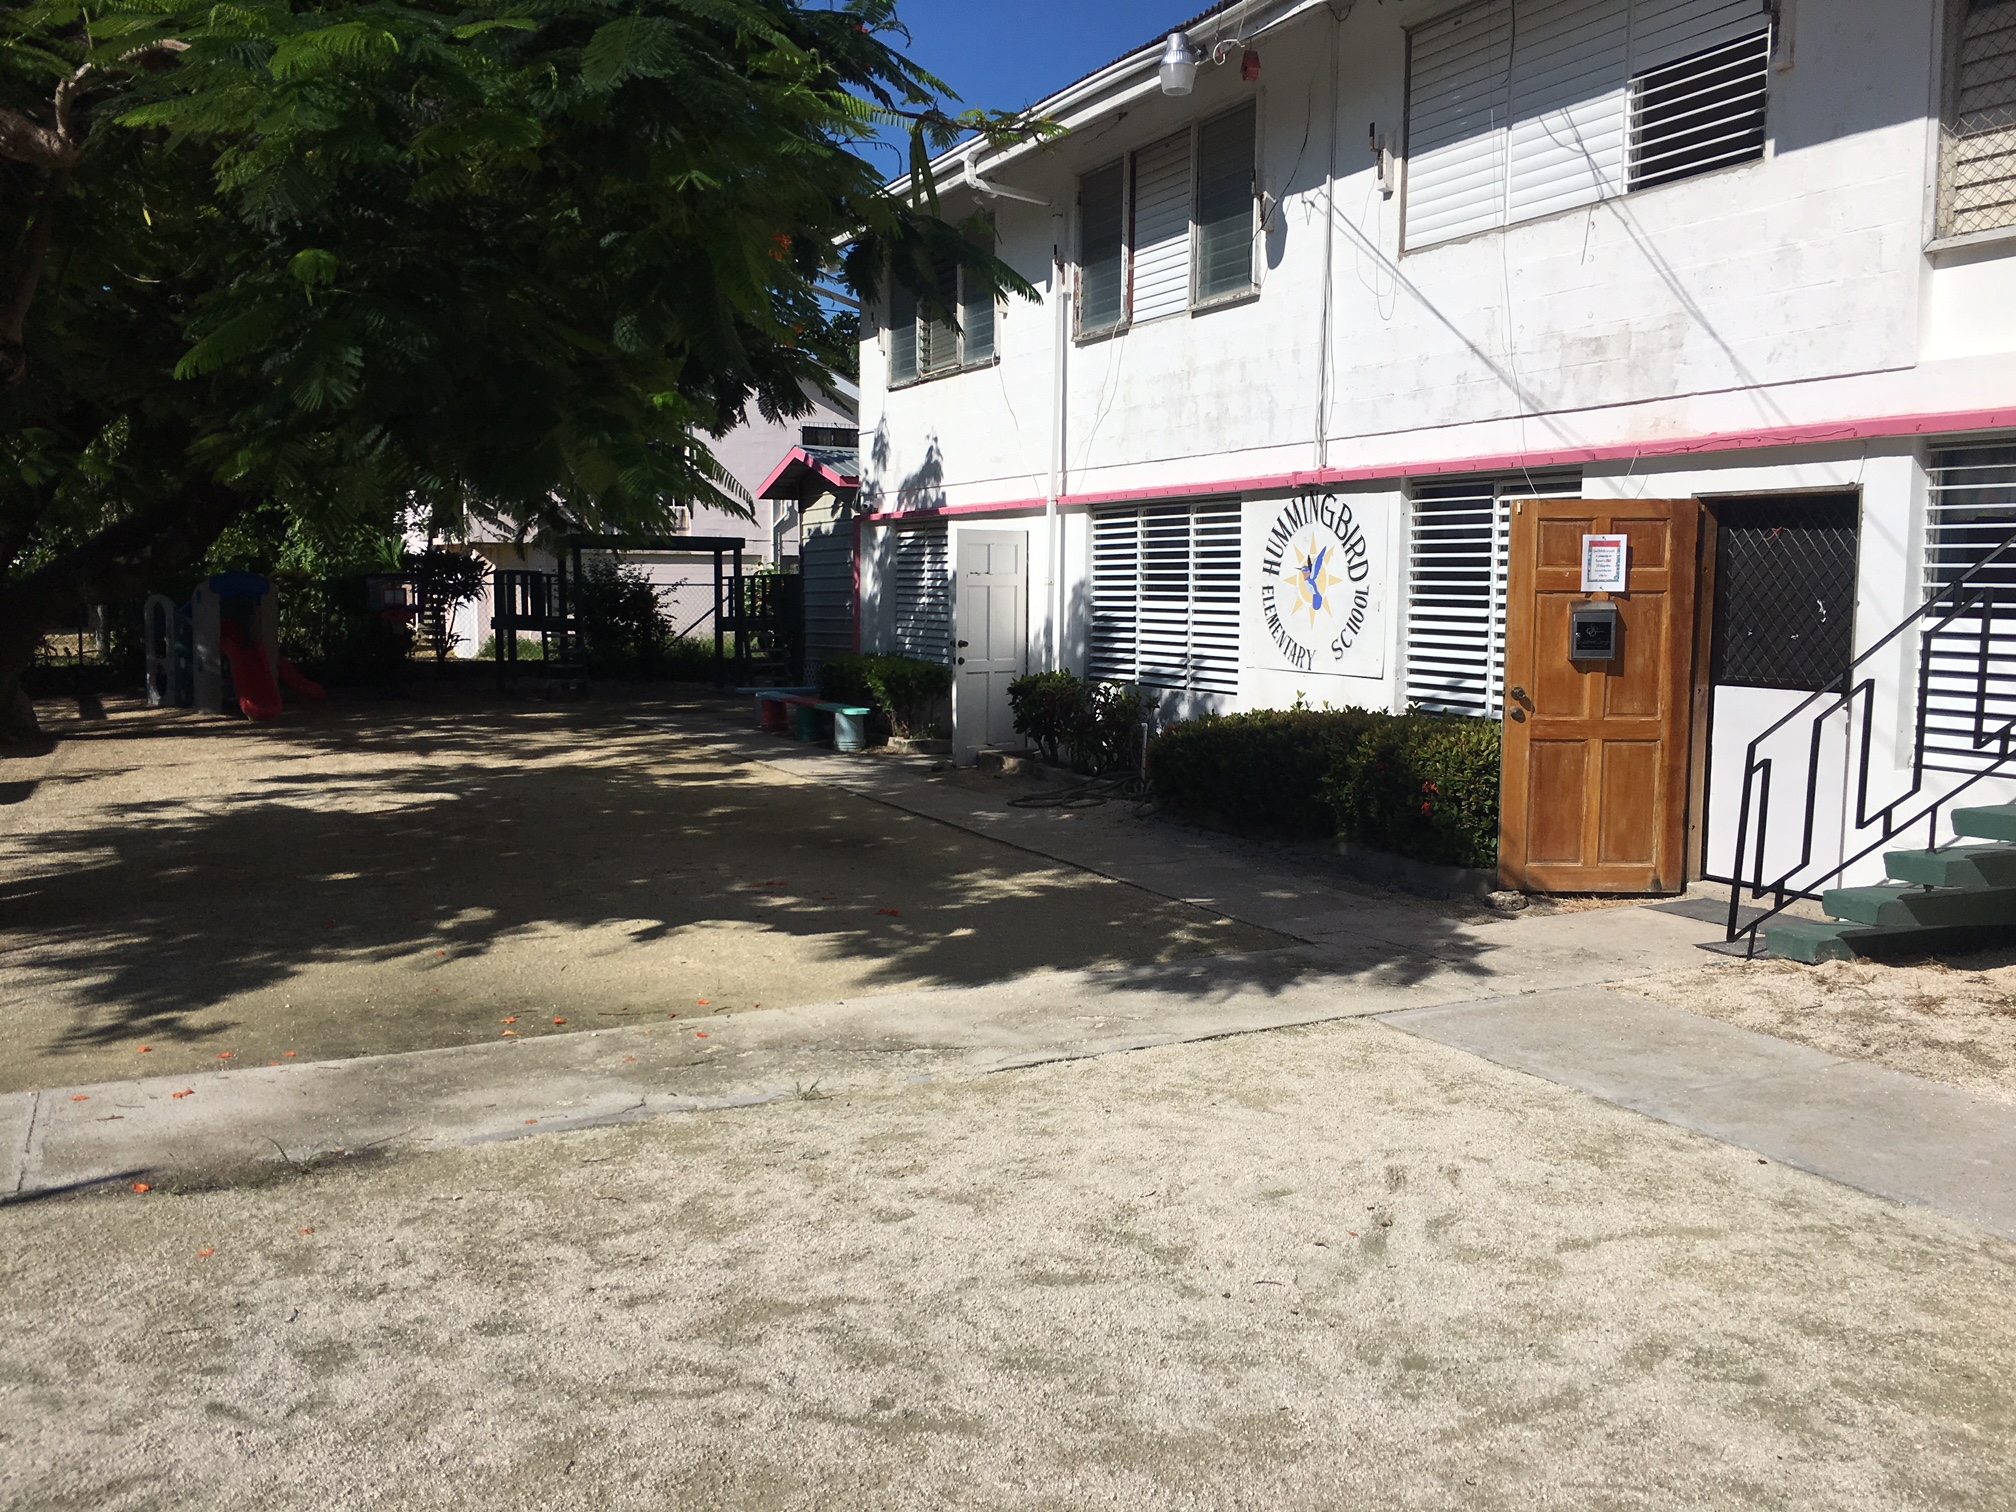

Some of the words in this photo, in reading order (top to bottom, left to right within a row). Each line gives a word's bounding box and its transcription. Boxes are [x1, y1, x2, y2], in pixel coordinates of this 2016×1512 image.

[1262, 490, 1369, 582] HUMMINGBIRD
[1262, 585, 1316, 671] ELEMENTARY
[1331, 585, 1370, 661] SCHOOL
